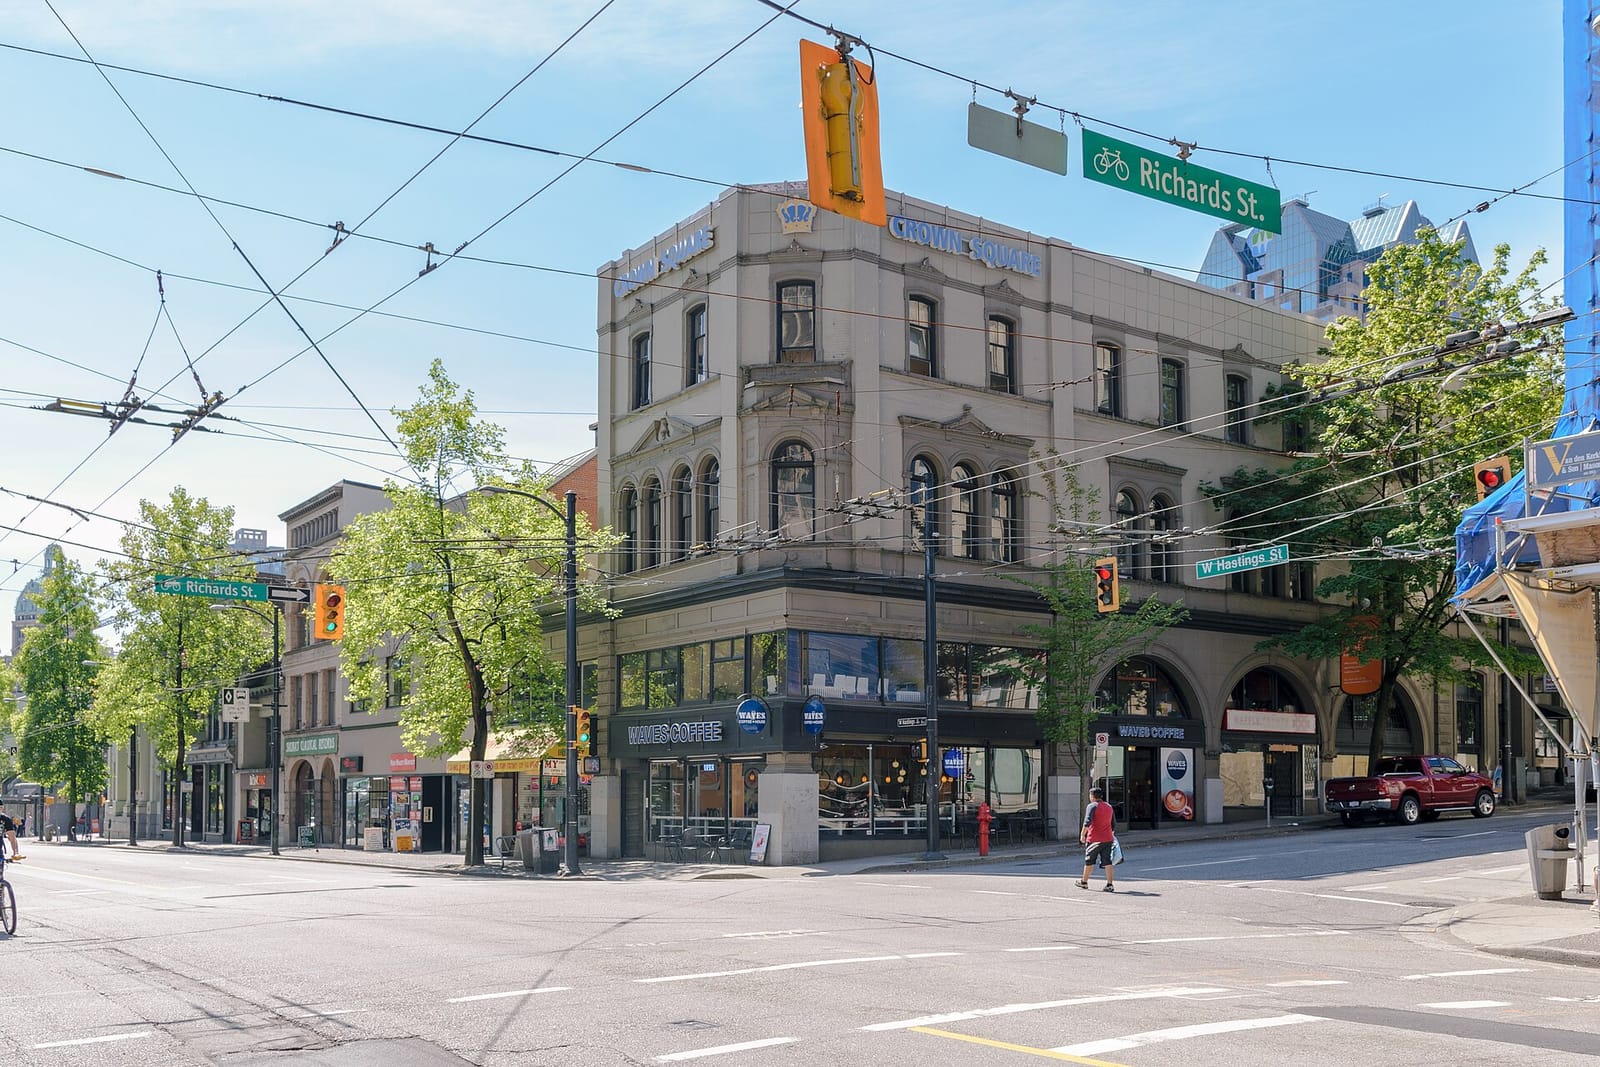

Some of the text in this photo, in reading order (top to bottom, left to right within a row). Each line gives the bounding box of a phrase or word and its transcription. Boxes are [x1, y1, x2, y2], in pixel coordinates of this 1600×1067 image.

[1139, 157, 1265, 222] Richards St.
[659, 224, 714, 273] SQUARE
[889, 215, 1042, 278] CROWN SQUARE
[1568, 465, 1579, 473] Son
[1201, 548, 1283, 574] W Hastings St
[186, 580, 257, 598] Richards St.
[738, 710, 766, 720] WAVES
[804, 711, 824, 720] WAVES
[627, 721, 722, 744] WAVES COFFEE
[1119, 725, 1185, 739] WAVES COFFEE
[544, 760, 558, 768] MY
